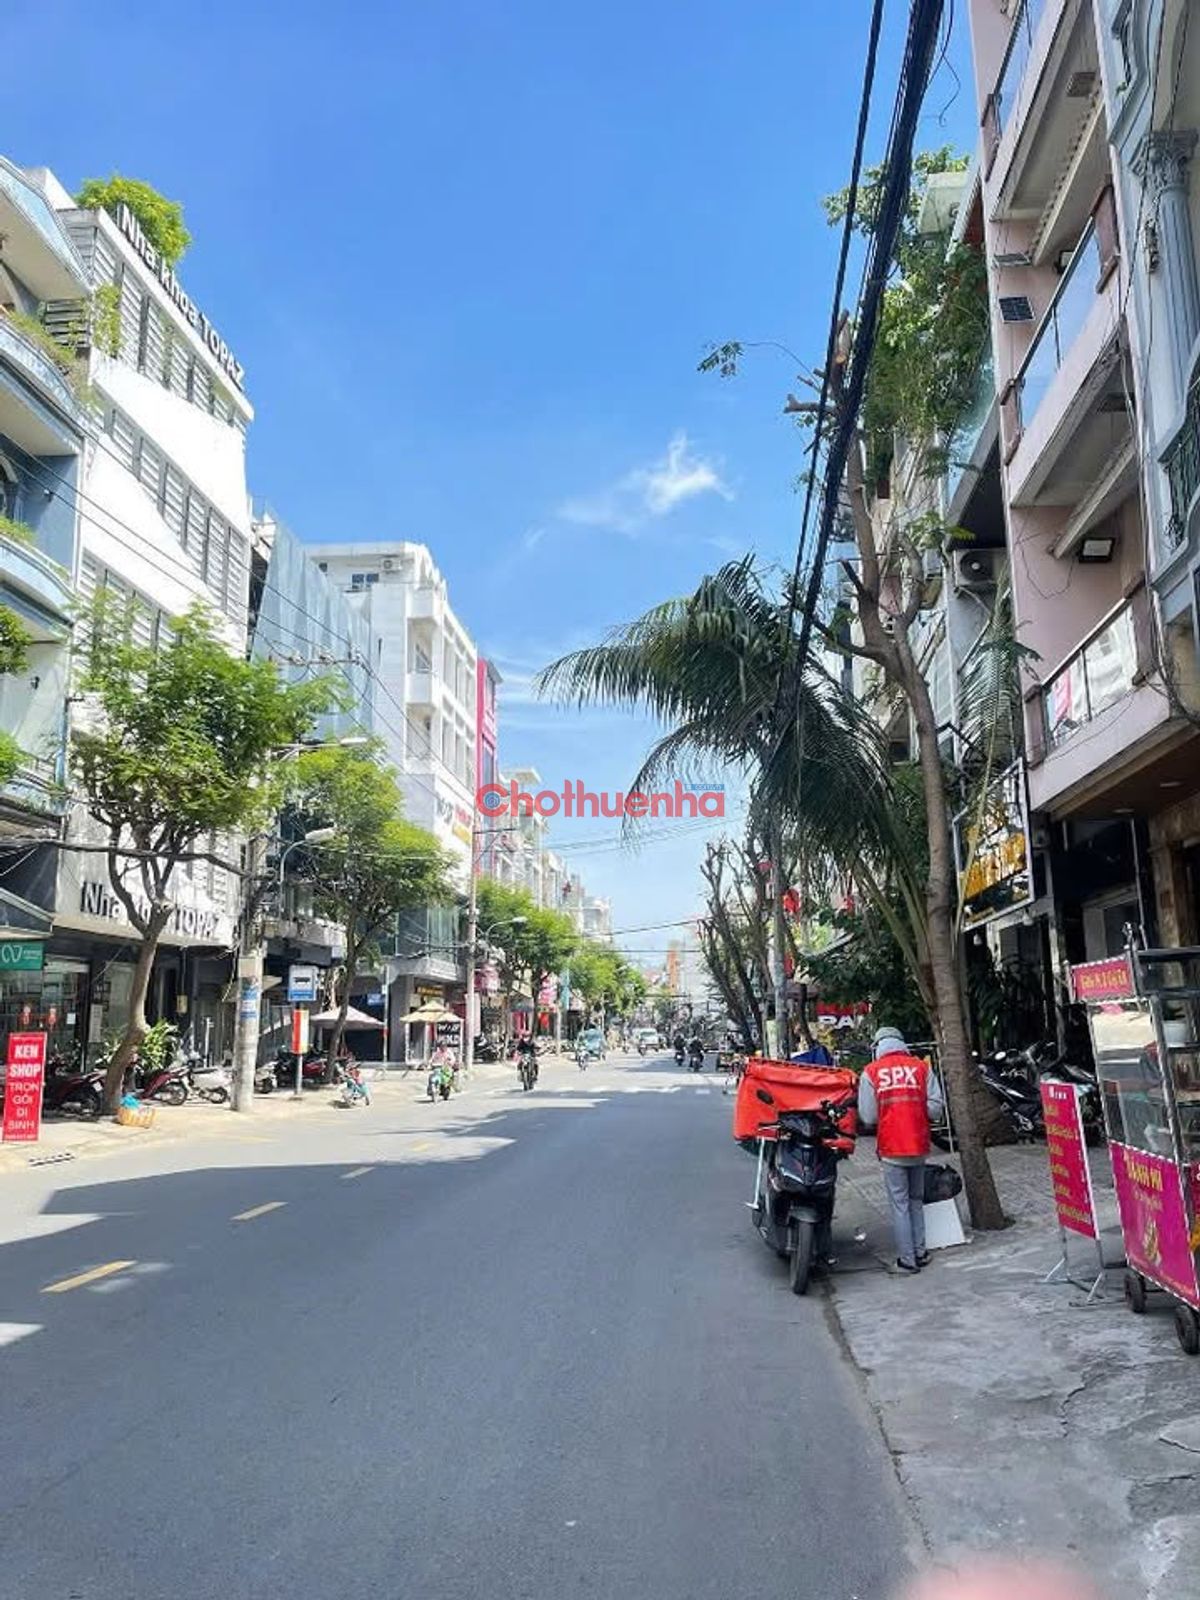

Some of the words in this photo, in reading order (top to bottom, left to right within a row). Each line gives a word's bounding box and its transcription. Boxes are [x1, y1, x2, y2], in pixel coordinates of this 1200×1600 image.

[14, 1044, 39, 1059] KEN
[10, 1063, 41, 1078] SHOP
[877, 1066, 918, 1087] SPX
